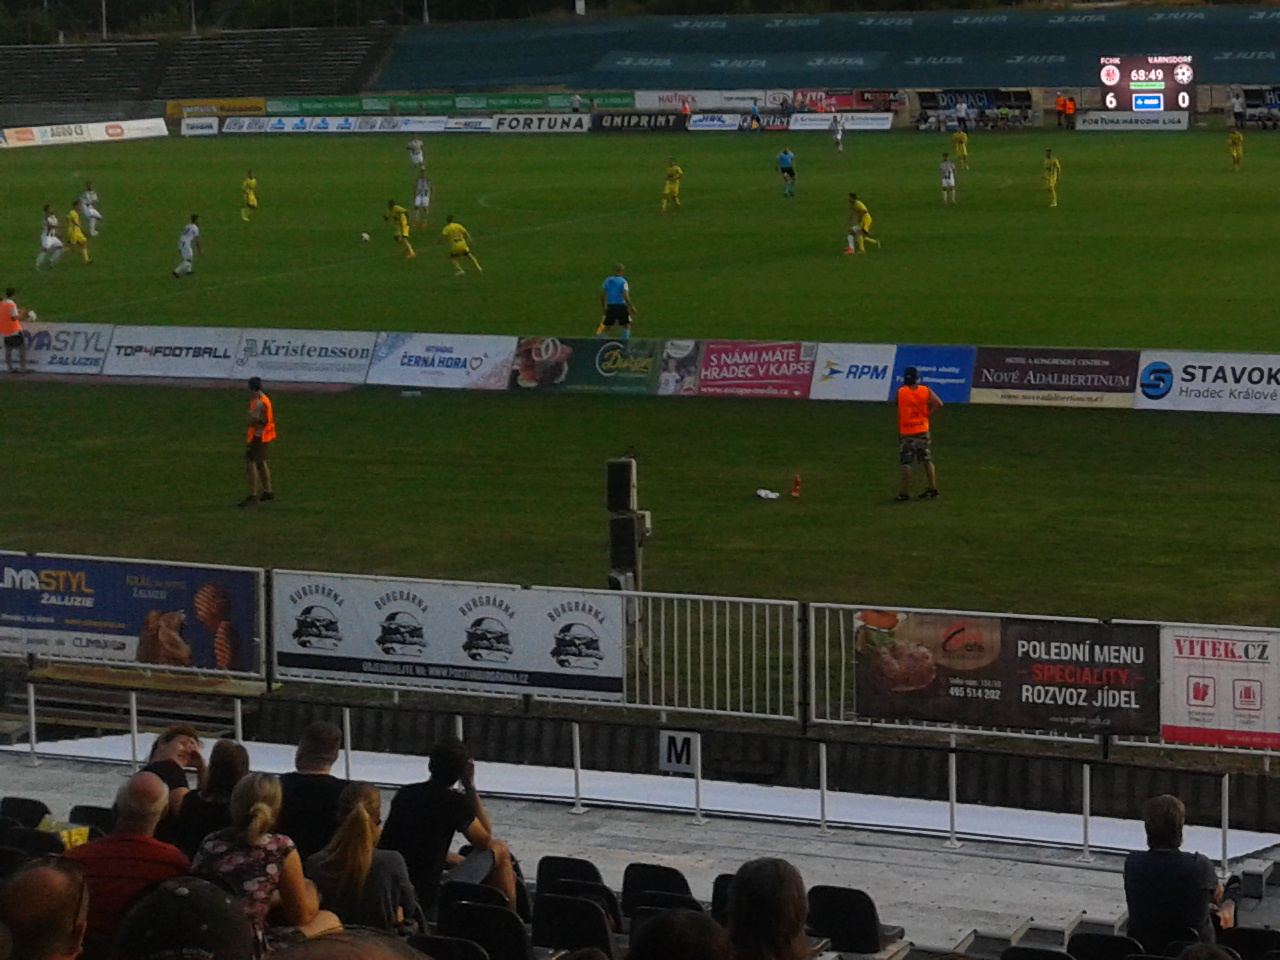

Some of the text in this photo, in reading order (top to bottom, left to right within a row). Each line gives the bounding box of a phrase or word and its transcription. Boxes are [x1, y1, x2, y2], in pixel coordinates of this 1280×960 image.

[1130, 68, 1164, 81] 68:49
[1105, 91, 1118, 109] 6
[1177, 91, 1190, 108] 0
[496, 116, 586, 131] FORTUNA
[601, 113, 677, 127] UNIPRINT
[114, 344, 232, 363] TOP4FOOTBALL
[260, 342, 371, 361] Kristensson
[400, 351, 468, 369] ČERNÁ HORA
[709, 352, 719, 366] S
[760, 346, 797, 363] MÁTE
[700, 361, 812, 380] HRADEC V KAPSE
[845, 364, 889, 384] RPM
[1179, 386, 1224, 399] Hradec
[1228, 387, 1277, 402] Králové
[40, 592, 95, 608] ŽALUZIE
[1017, 639, 1145, 664] POLEDNÍ MENU
[1174, 637, 1271, 661] VÍTEK.CZ
[1031, 663, 1130, 686] SPECIALITY
[1021, 684, 1141, 708] ROZVOZ JÍDEL
[667, 735, 692, 766] M
